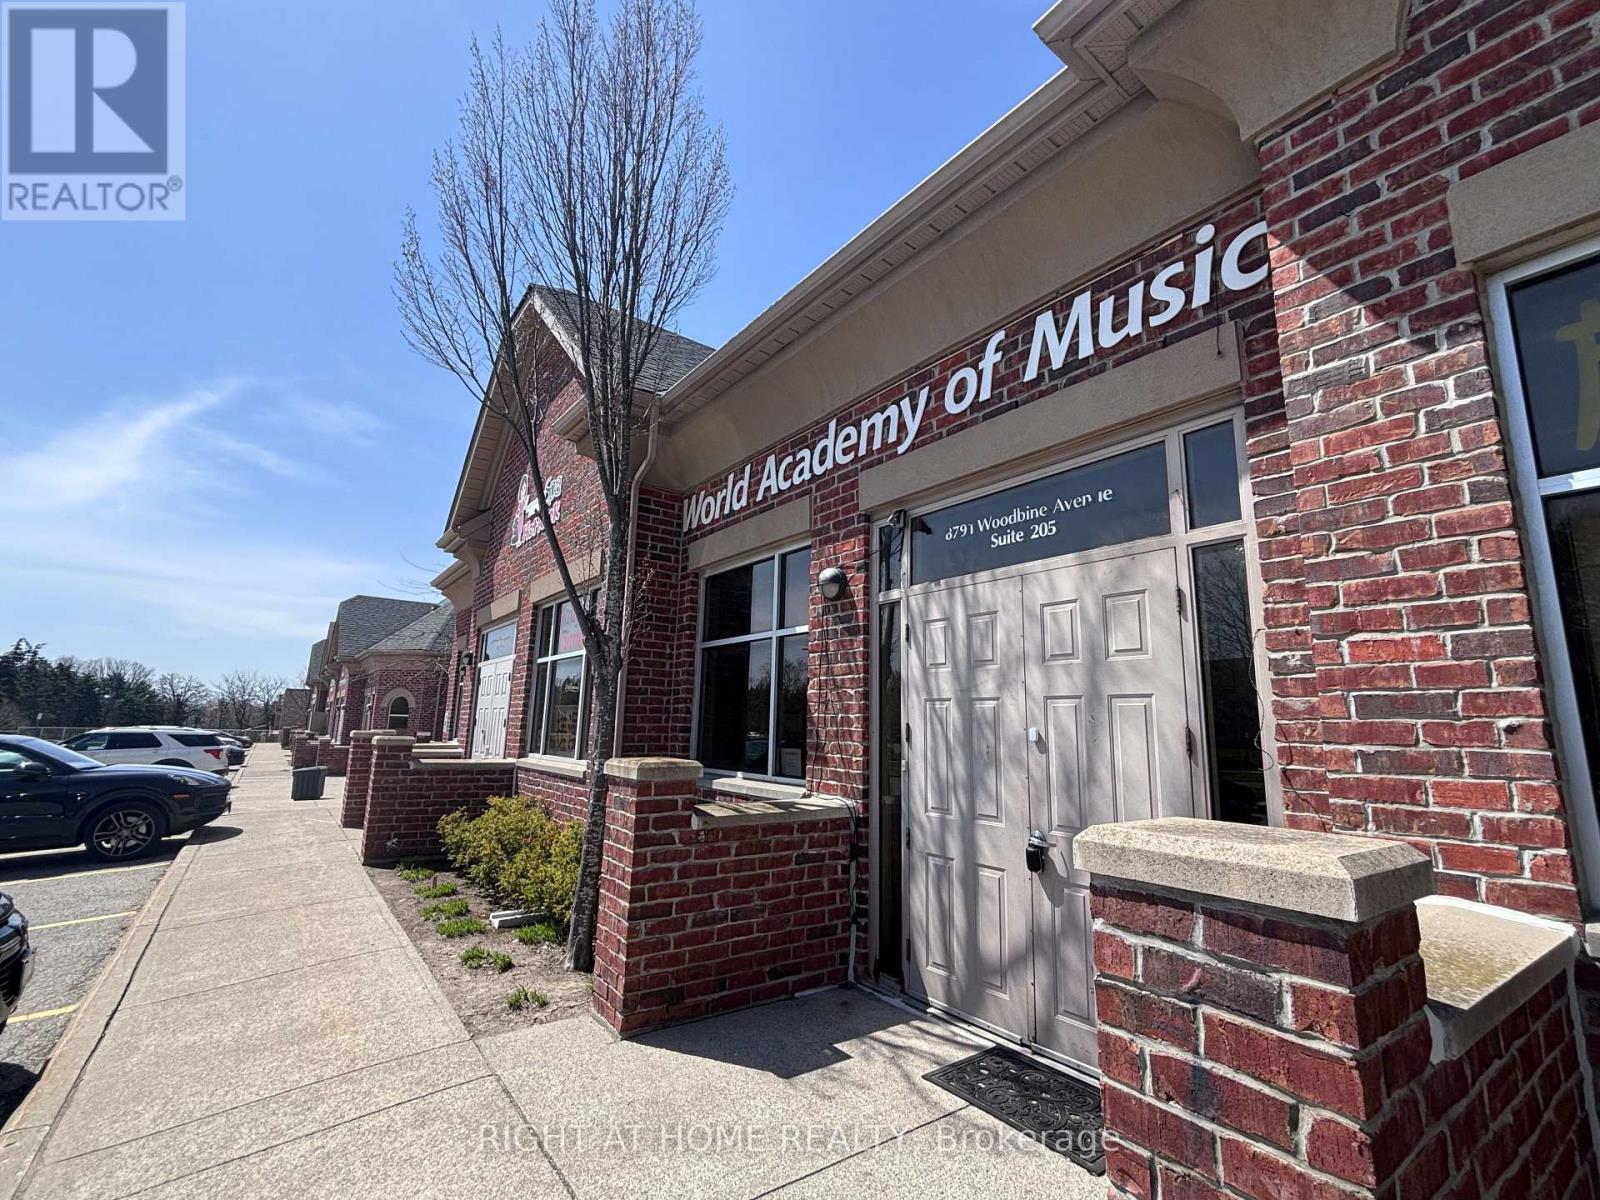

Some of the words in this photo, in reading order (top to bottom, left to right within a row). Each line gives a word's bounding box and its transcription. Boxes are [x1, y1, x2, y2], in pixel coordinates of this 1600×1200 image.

[682, 463, 751, 532] World
[756, 386, 929, 502] Academy
[944, 330, 1006, 415] of
[1023, 221, 1269, 383] Music
[977, 504, 1048, 533] Woodbine
[990, 531, 1025, 548] Suite
[1030, 520, 1057, 540] 205
